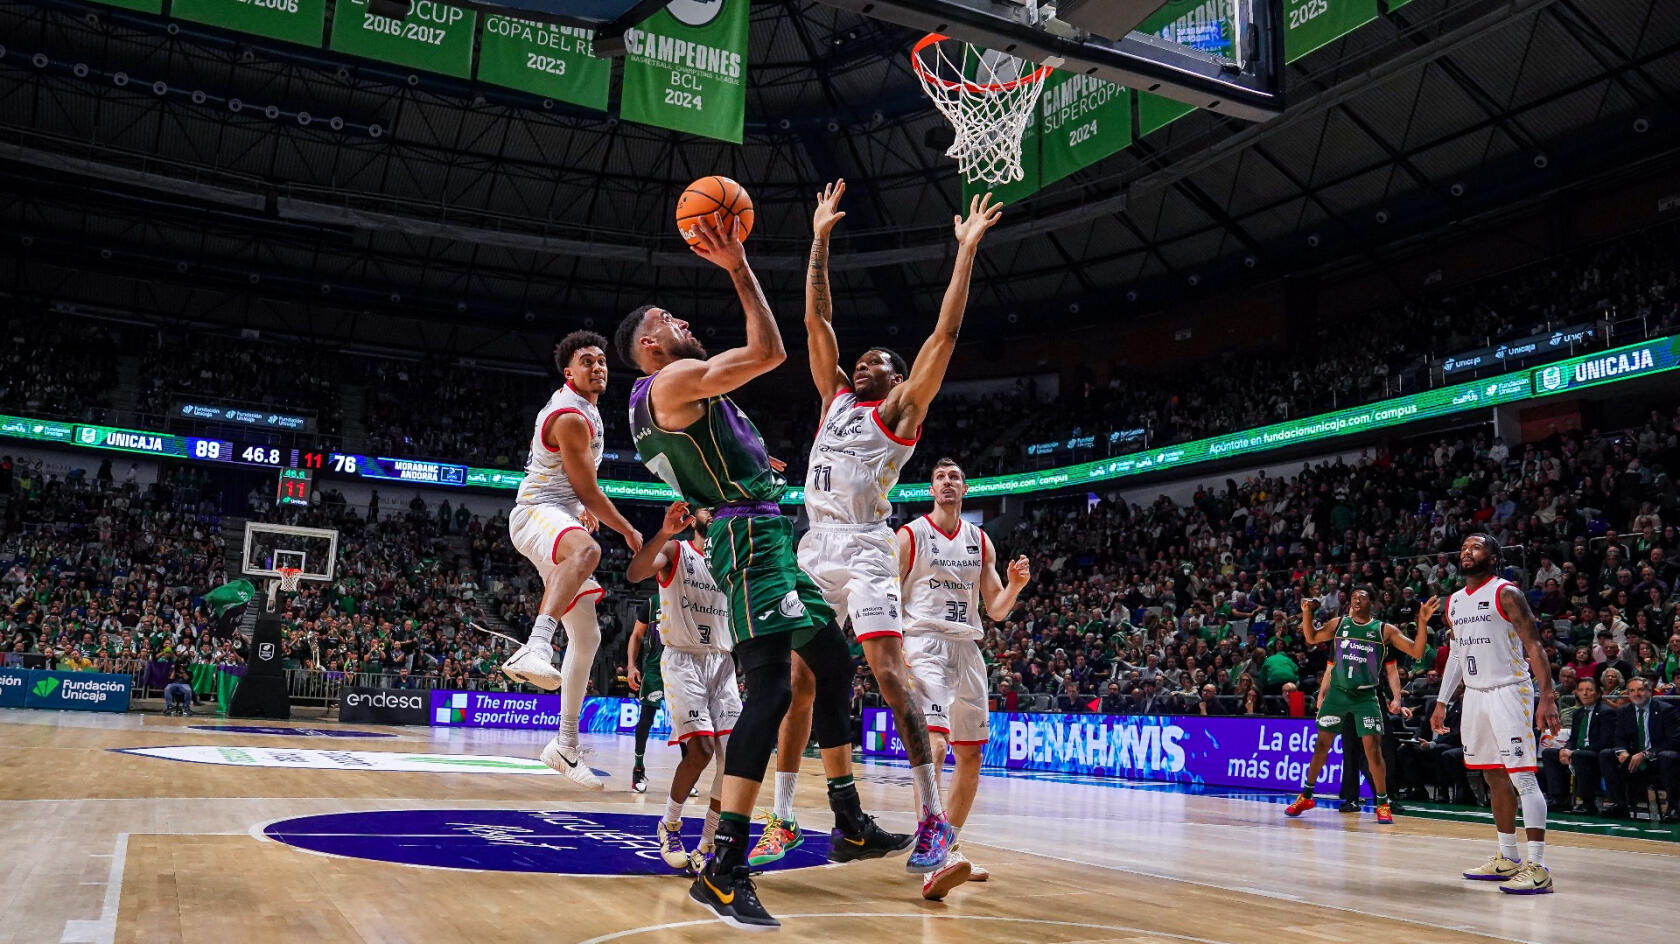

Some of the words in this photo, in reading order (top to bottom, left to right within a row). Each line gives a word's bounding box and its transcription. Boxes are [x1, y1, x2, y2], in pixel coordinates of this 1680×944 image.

[1289, 0, 1328, 30] 2025
[363, 13, 446, 46] 2016/2017
[487, 18, 533, 43] COPA
[537, 31, 571, 51] DEL
[576, 42, 605, 60] RE
[630, 29, 741, 78] CAMPEONES
[527, 53, 567, 75] 2023
[671, 70, 703, 91] BCL
[665, 88, 703, 111] 2024
[1044, 83, 1127, 134] SUPERCOPA
[1069, 119, 1098, 147] 2024
[1508, 343, 1536, 356] Unicaja
[1575, 348, 1653, 382] UNICAJA
[1208, 438, 1249, 455] Apúntate
[1250, 436, 1262, 446] en
[1263, 403, 1418, 443] fundacionunicaja.com/campus
[107, 432, 163, 451] UNICAJA
[195, 440, 221, 459] 89
[242, 446, 280, 464] 46.8
[304, 452, 323, 469] 11
[334, 455, 356, 473] 76
[394, 461, 439, 473] MORABANC
[400, 470, 438, 481] ANDORRA
[813, 465, 832, 492] 11
[285, 481, 305, 498] 11
[899, 488, 933, 498] Apúnta
[939, 559, 981, 568] MORABANC
[945, 601, 968, 622] 32
[1453, 614, 1492, 626] MORABANC
[1349, 643, 1374, 653] Unicaja
[1459, 636, 1491, 647] Andorra
[1347, 665, 1354, 679] 1
[1466, 656, 1478, 676] 0
[62, 679, 125, 693] Fundación
[62, 689, 107, 703] Unicaja
[346, 691, 422, 709] endesa
[475, 695, 503, 710] The
[504, 697, 538, 711] most
[474, 711, 530, 727] sportive
[532, 712, 562, 726] choi
[1009, 721, 1186, 773] BENAHAVIS
[1258, 725, 1283, 751] La
[1228, 753, 1270, 779] más
